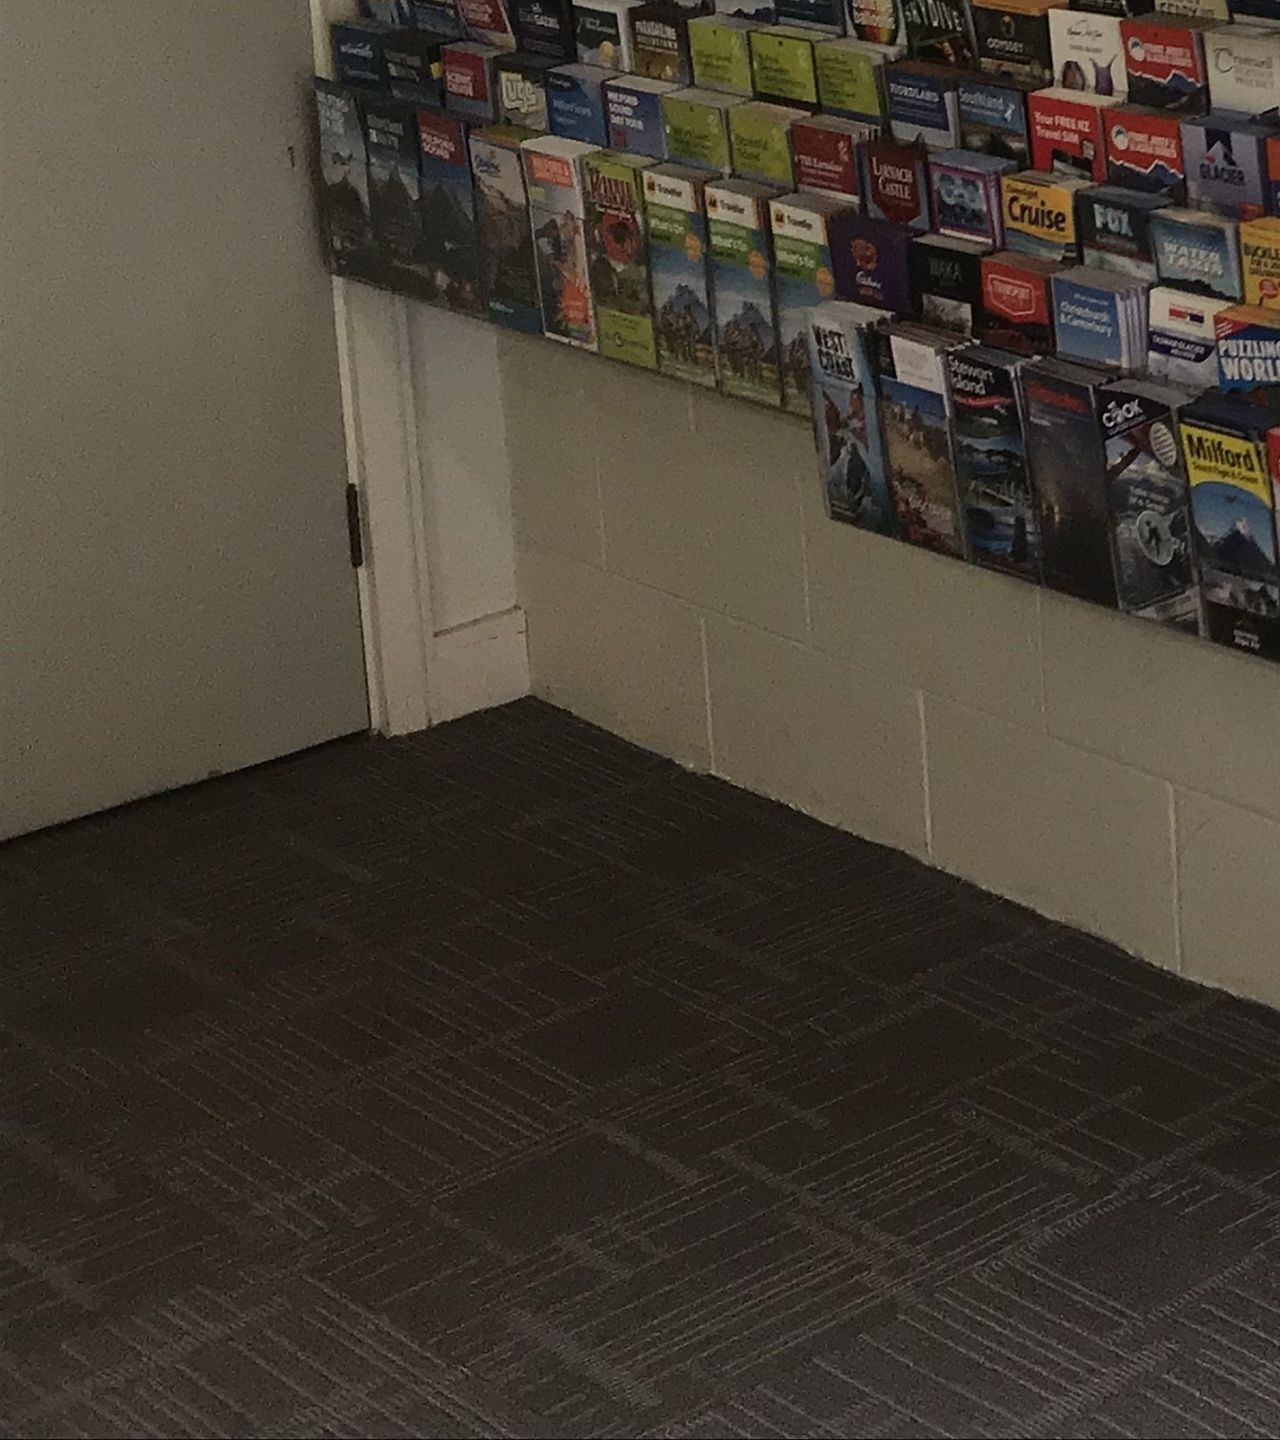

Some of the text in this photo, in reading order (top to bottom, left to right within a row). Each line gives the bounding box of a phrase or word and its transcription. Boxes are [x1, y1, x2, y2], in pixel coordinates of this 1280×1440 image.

[1200, 162, 1245, 186] GLACIER
[1008, 195, 1067, 233] Cruise
[1094, 203, 1133, 236] FOX
[1163, 242, 1221, 261] WATER
[1244, 242, 1280, 260] BUCKLE
[813, 324, 845, 350] WEST
[817, 349, 855, 380] COAST
[1187, 434, 1255, 472] Milford
